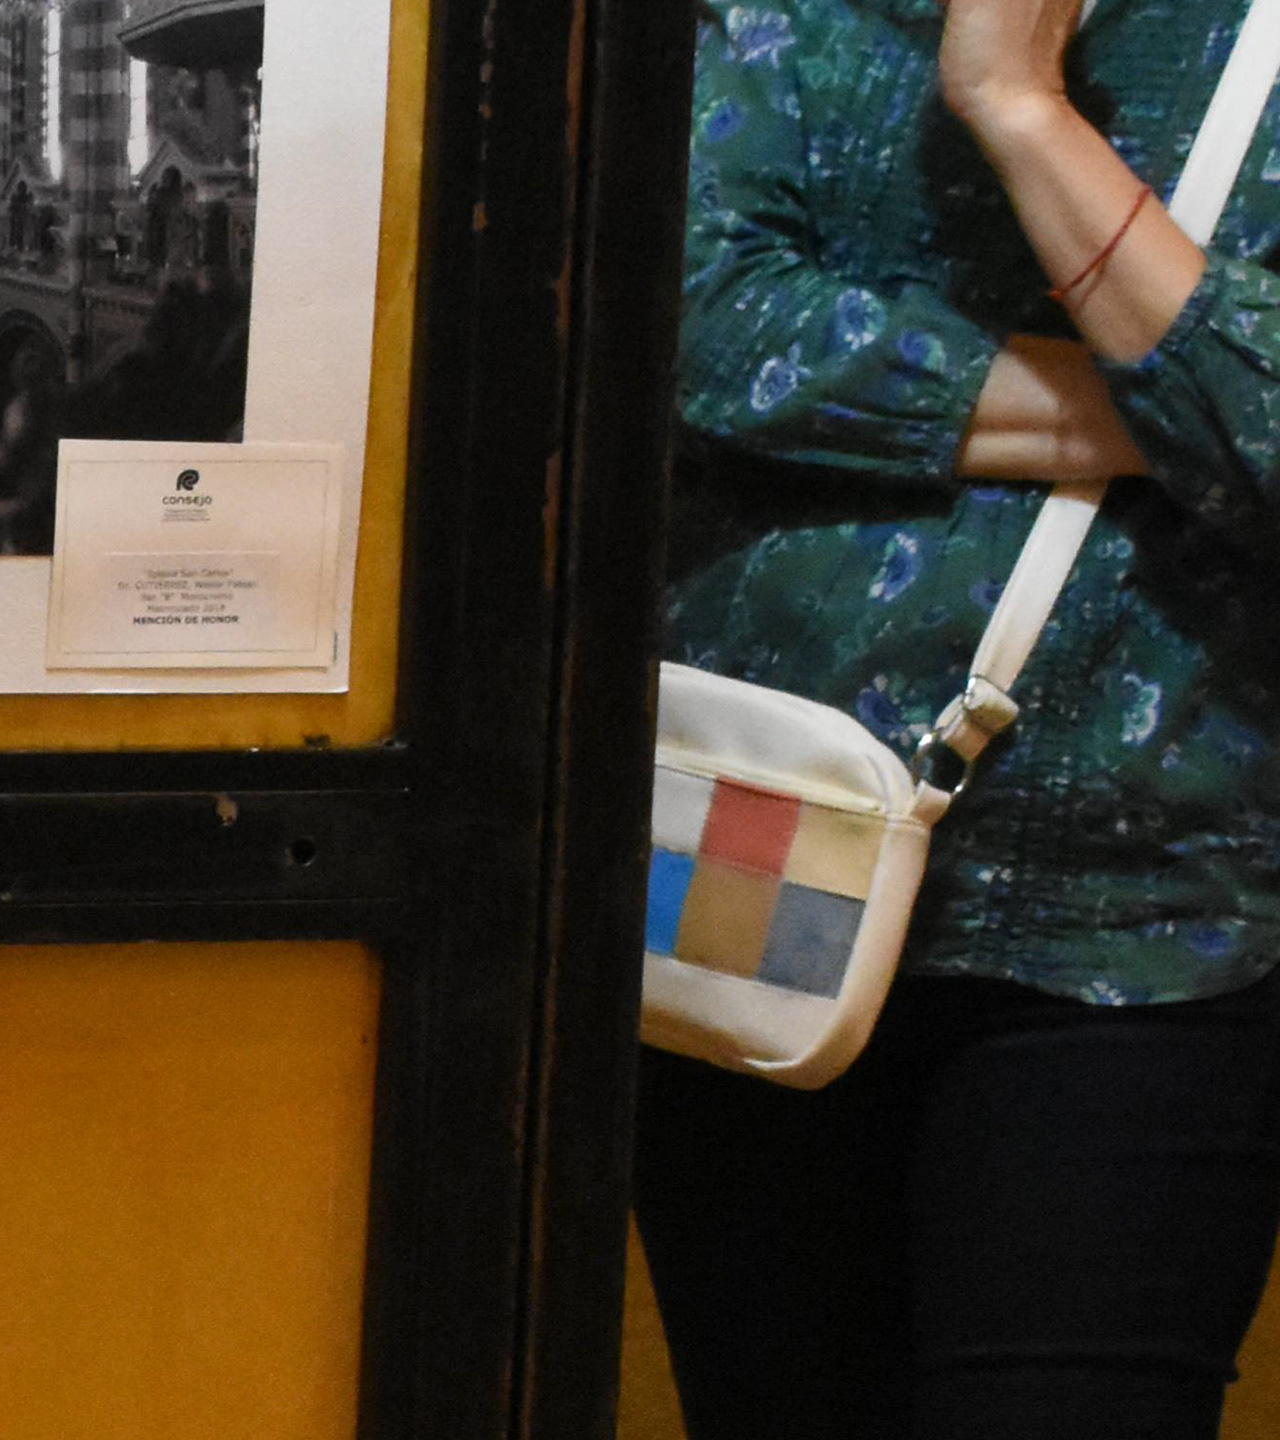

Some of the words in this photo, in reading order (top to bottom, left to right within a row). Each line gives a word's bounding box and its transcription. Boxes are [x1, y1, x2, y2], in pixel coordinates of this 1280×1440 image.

[161, 495, 213, 507] consejo
[132, 614, 182, 626] MENCIÓN
[184, 615, 199, 625] DE
[202, 615, 239, 624] HONOR
